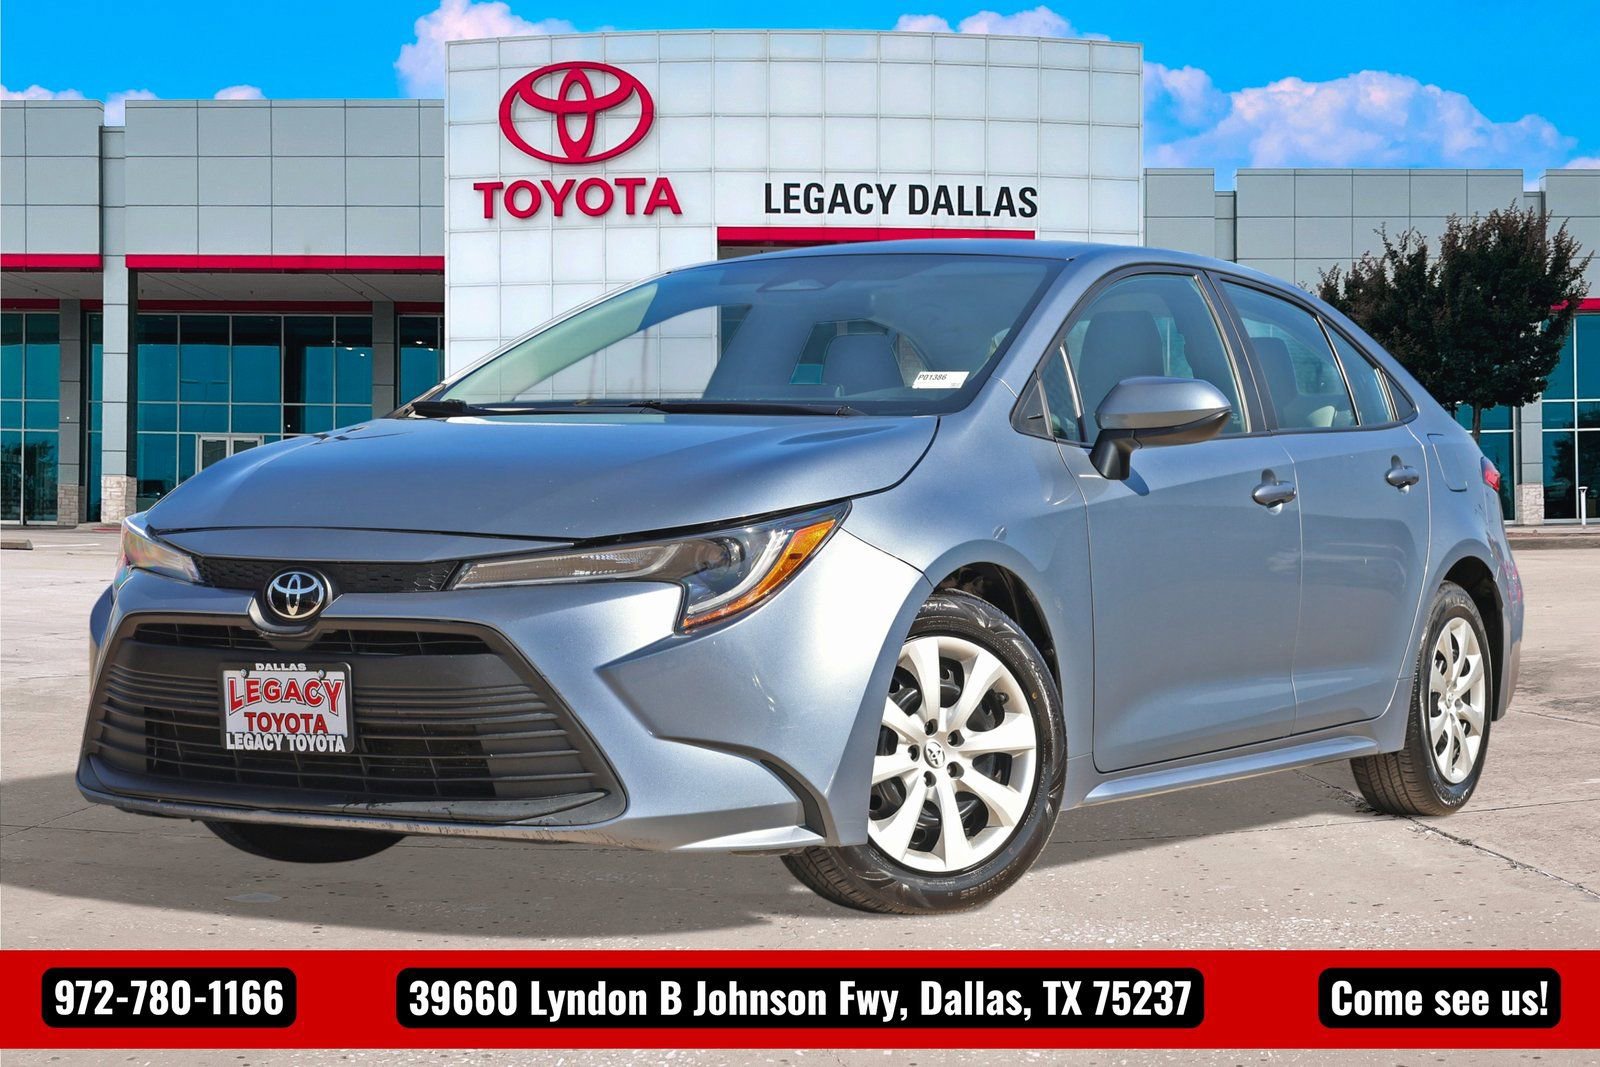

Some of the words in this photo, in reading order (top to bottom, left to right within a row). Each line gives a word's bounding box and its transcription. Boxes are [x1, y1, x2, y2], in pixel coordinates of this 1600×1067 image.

[474, 177, 682, 218] TOYOTA
[765, 183, 897, 214] LEGACY
[909, 185, 1038, 217] DALLAS
[255, 663, 307, 671] DALLAS
[228, 677, 344, 716] LEGACY
[244, 712, 329, 734] TOYOTA
[226, 732, 283, 751] LEGACY
[286, 733, 346, 753] TOYOTA
